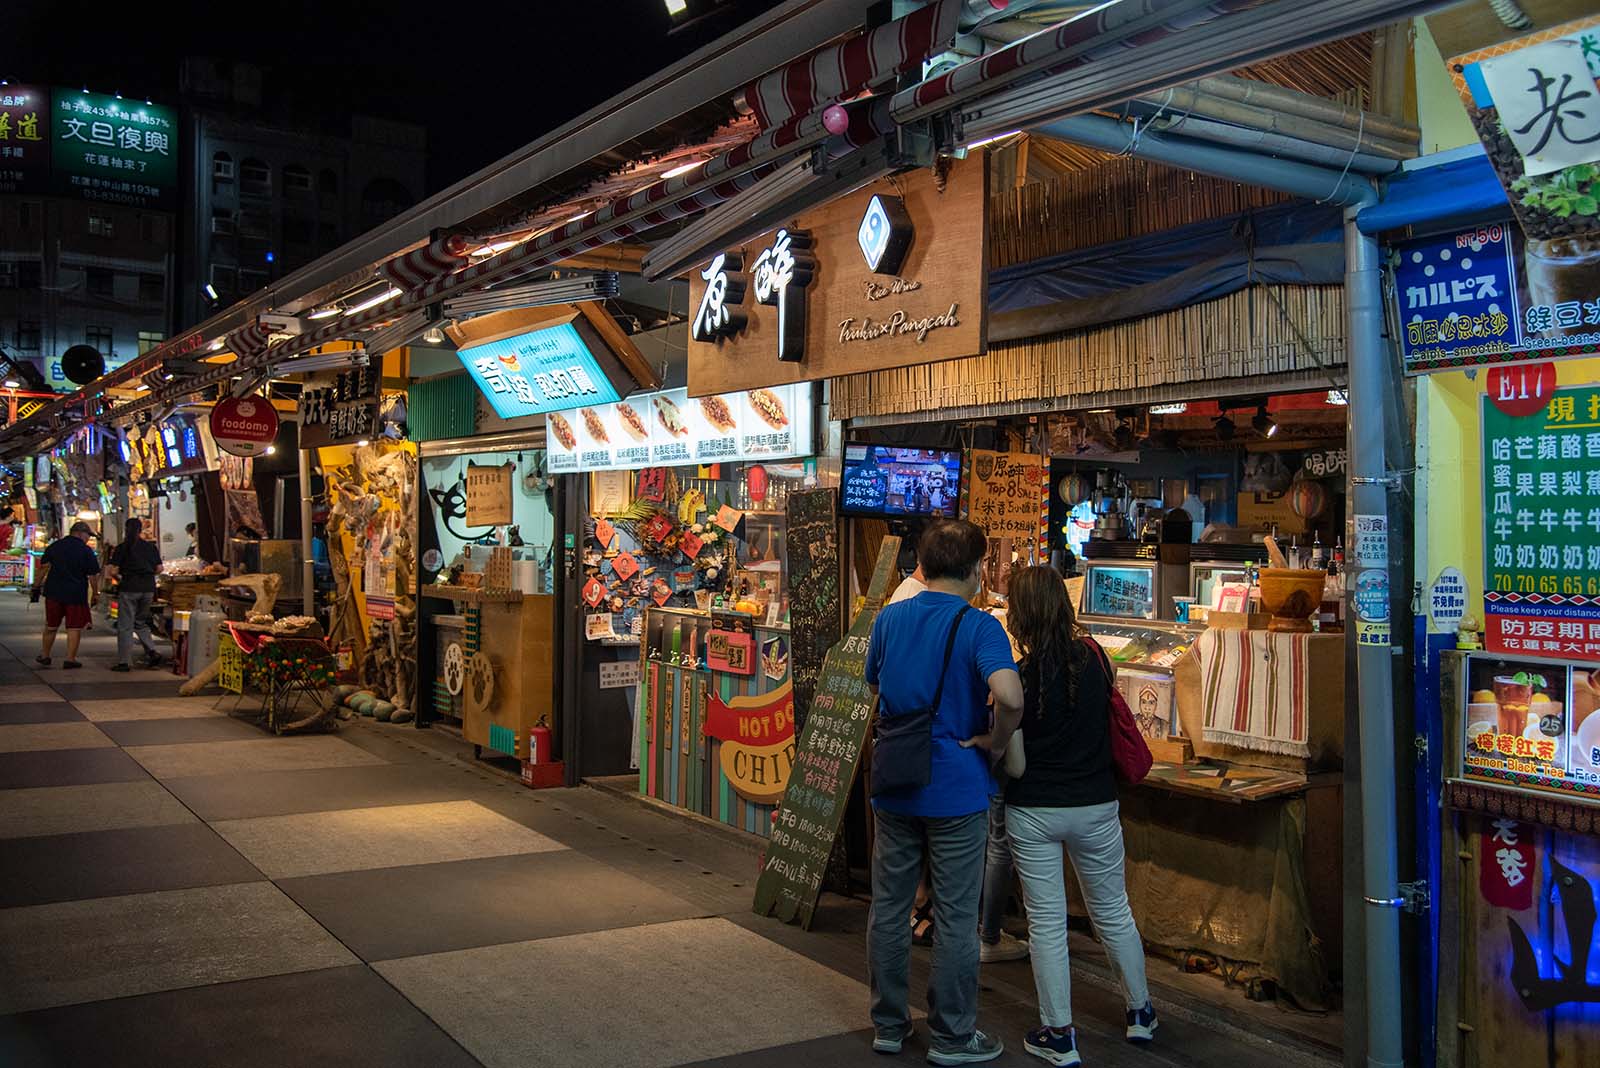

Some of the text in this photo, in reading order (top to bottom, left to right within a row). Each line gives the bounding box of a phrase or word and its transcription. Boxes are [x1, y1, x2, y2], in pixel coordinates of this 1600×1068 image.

[1513, 68, 1600, 156] 老
[61, 117, 169, 156] 文旦復興
[865, 278, 921, 301] Rice Wine
[1406, 274, 1498, 309] カルピス
[1411, 342, 1510, 361] Calpis smoothie
[1497, 369, 1544, 401] E17
[222, 417, 269, 432] foodomo
[1492, 438, 1512, 568] 哈蜜瓜牛奶
[1514, 437, 1535, 569] 芒果牛奶
[1538, 435, 1559, 569] 蘋果牛奶
[1561, 433, 1583, 570] 酪梨牛奶
[1494, 574, 1512, 592] 70
[1516, 575, 1535, 592] 70
[1539, 575, 1558, 593] 65
[1563, 576, 1582, 594] 65
[1490, 604, 1519, 614] Please
[1521, 606, 1541, 616] keep
[1543, 608, 1562, 617] your
[739, 715, 770, 739] HOT
[1541, 718, 1561, 732] 25
[1476, 732, 1557, 760] 檸檬紅茶
[1466, 752, 1565, 778] Lemon Black Tea
